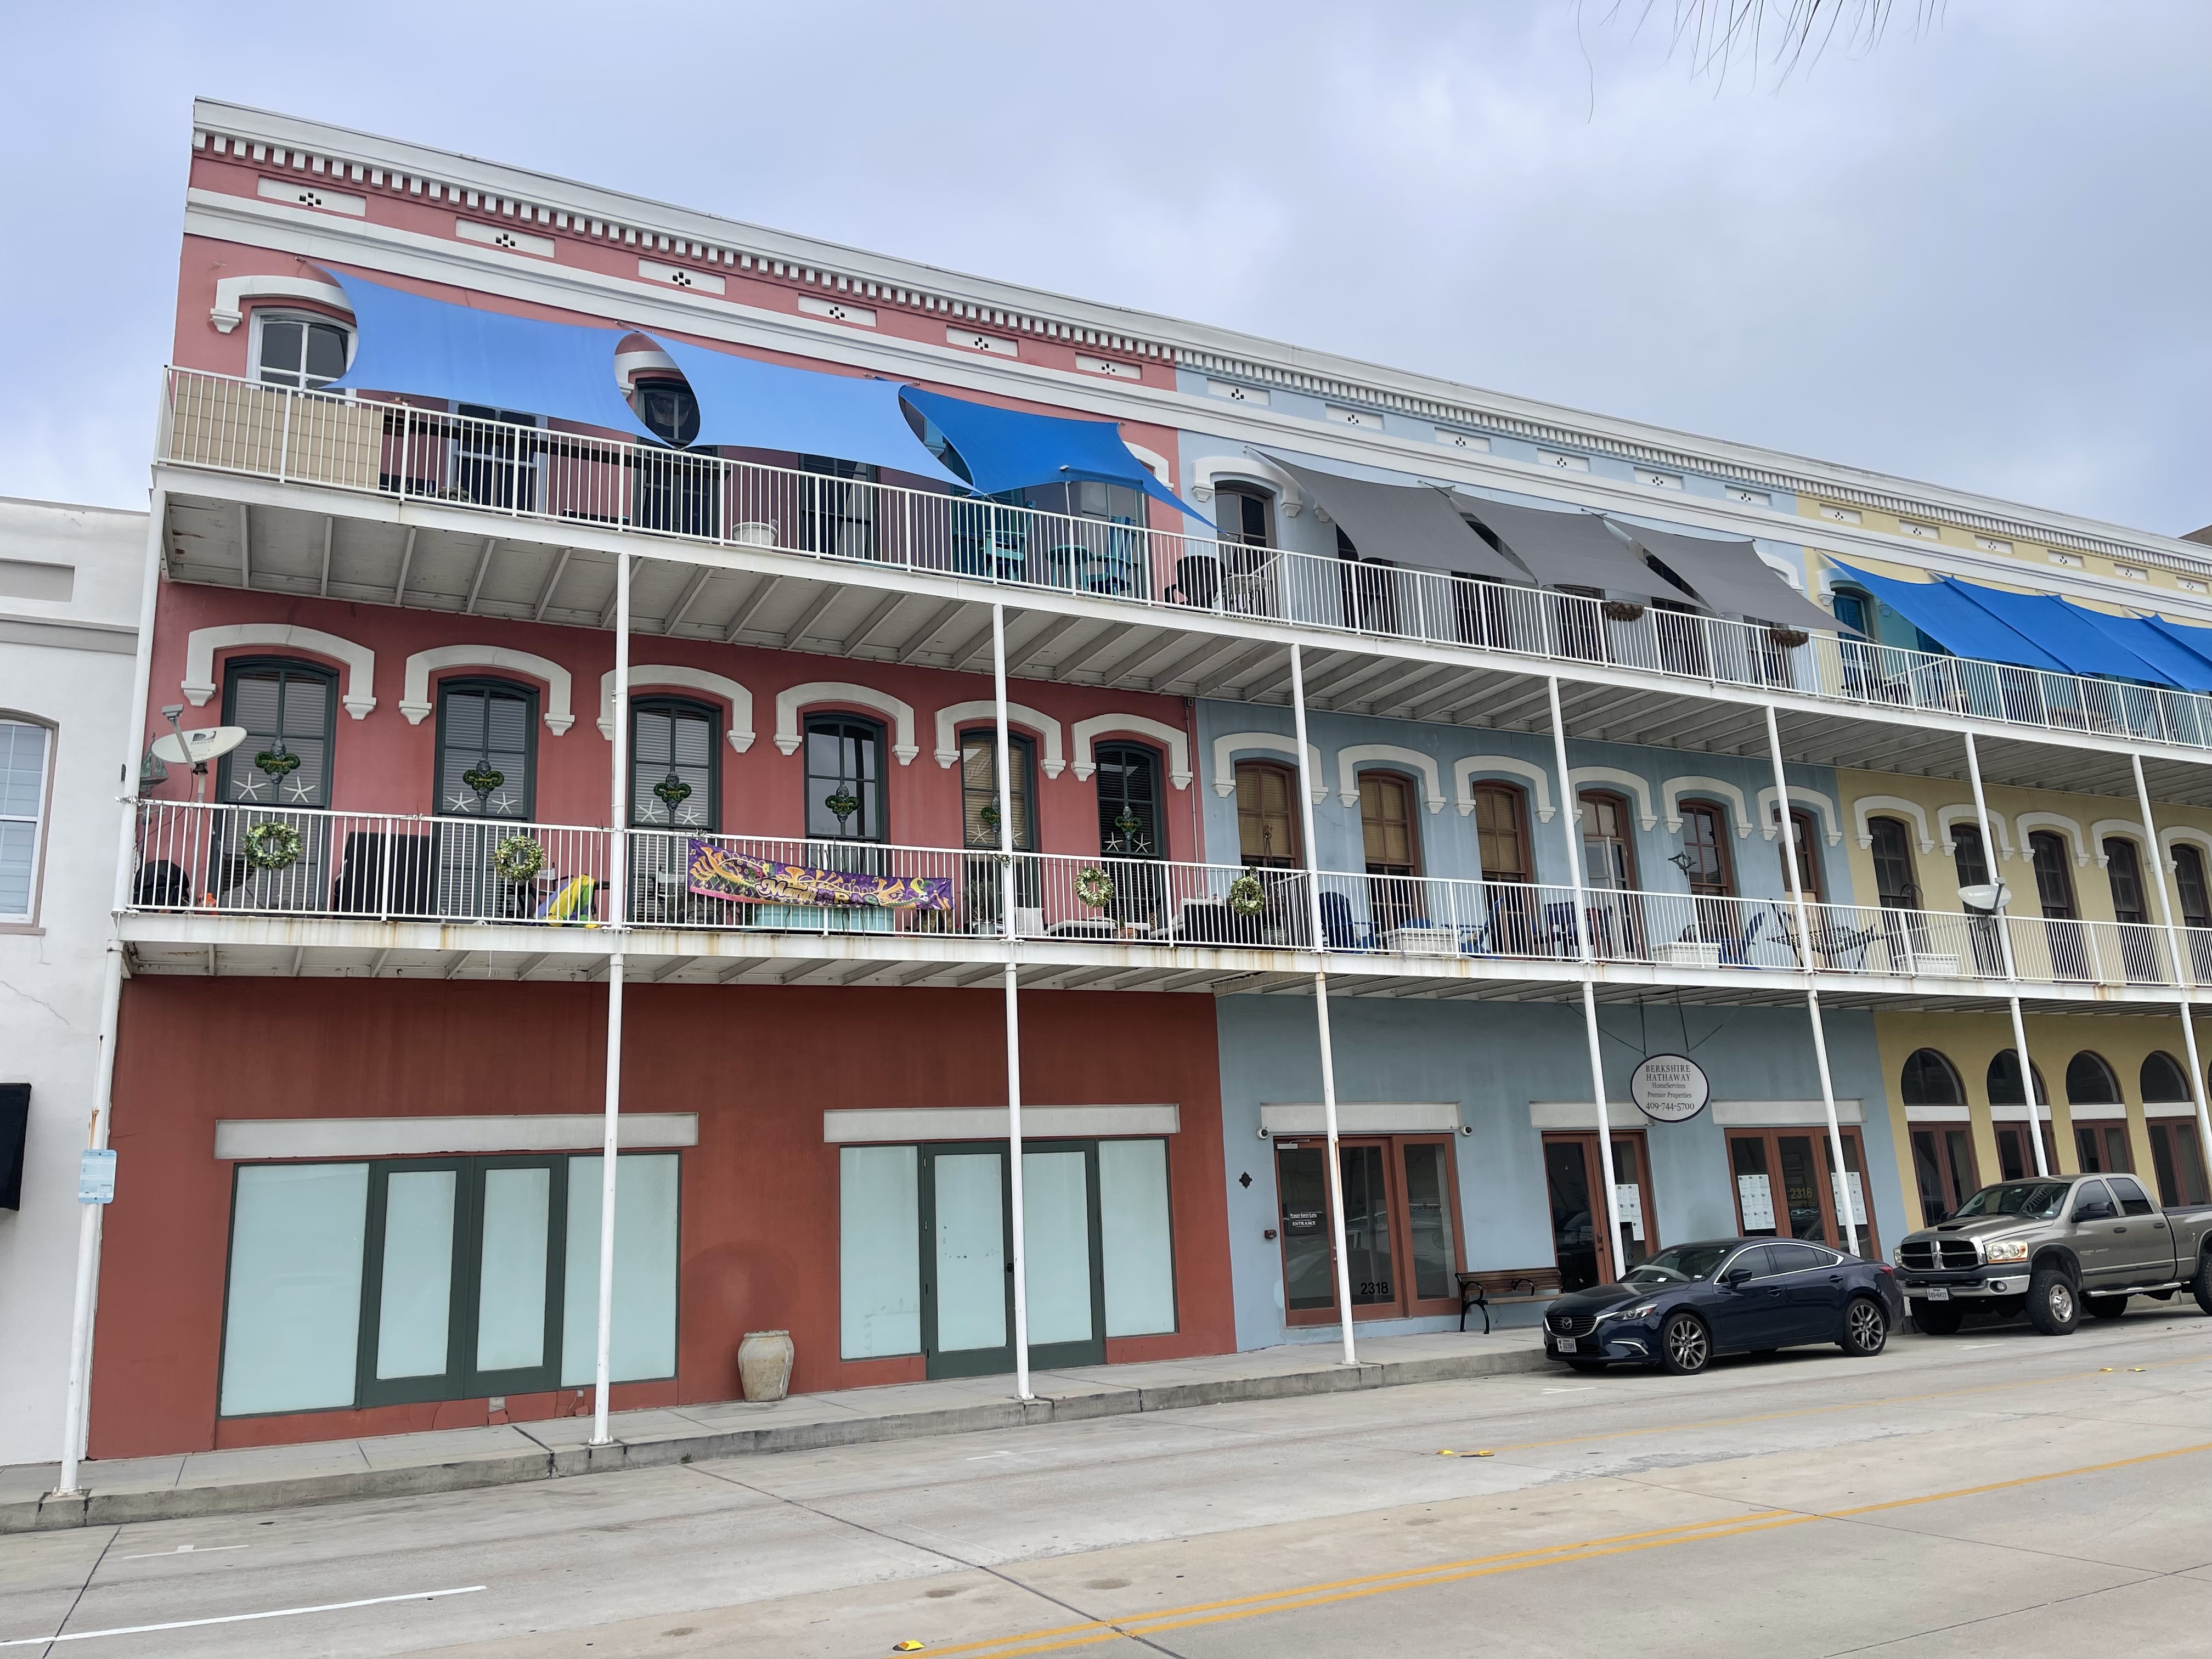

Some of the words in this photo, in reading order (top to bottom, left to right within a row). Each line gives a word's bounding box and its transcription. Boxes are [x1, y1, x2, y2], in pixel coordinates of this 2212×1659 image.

[754, 878, 818, 902] Mardi
[1646, 1064, 1691, 1073] BERKSHIRE
[1646, 1102, 1695, 1111] 409-744-5700
[1790, 1187, 1813, 1199] 2316
[1361, 1282, 1389, 1295] 2318
